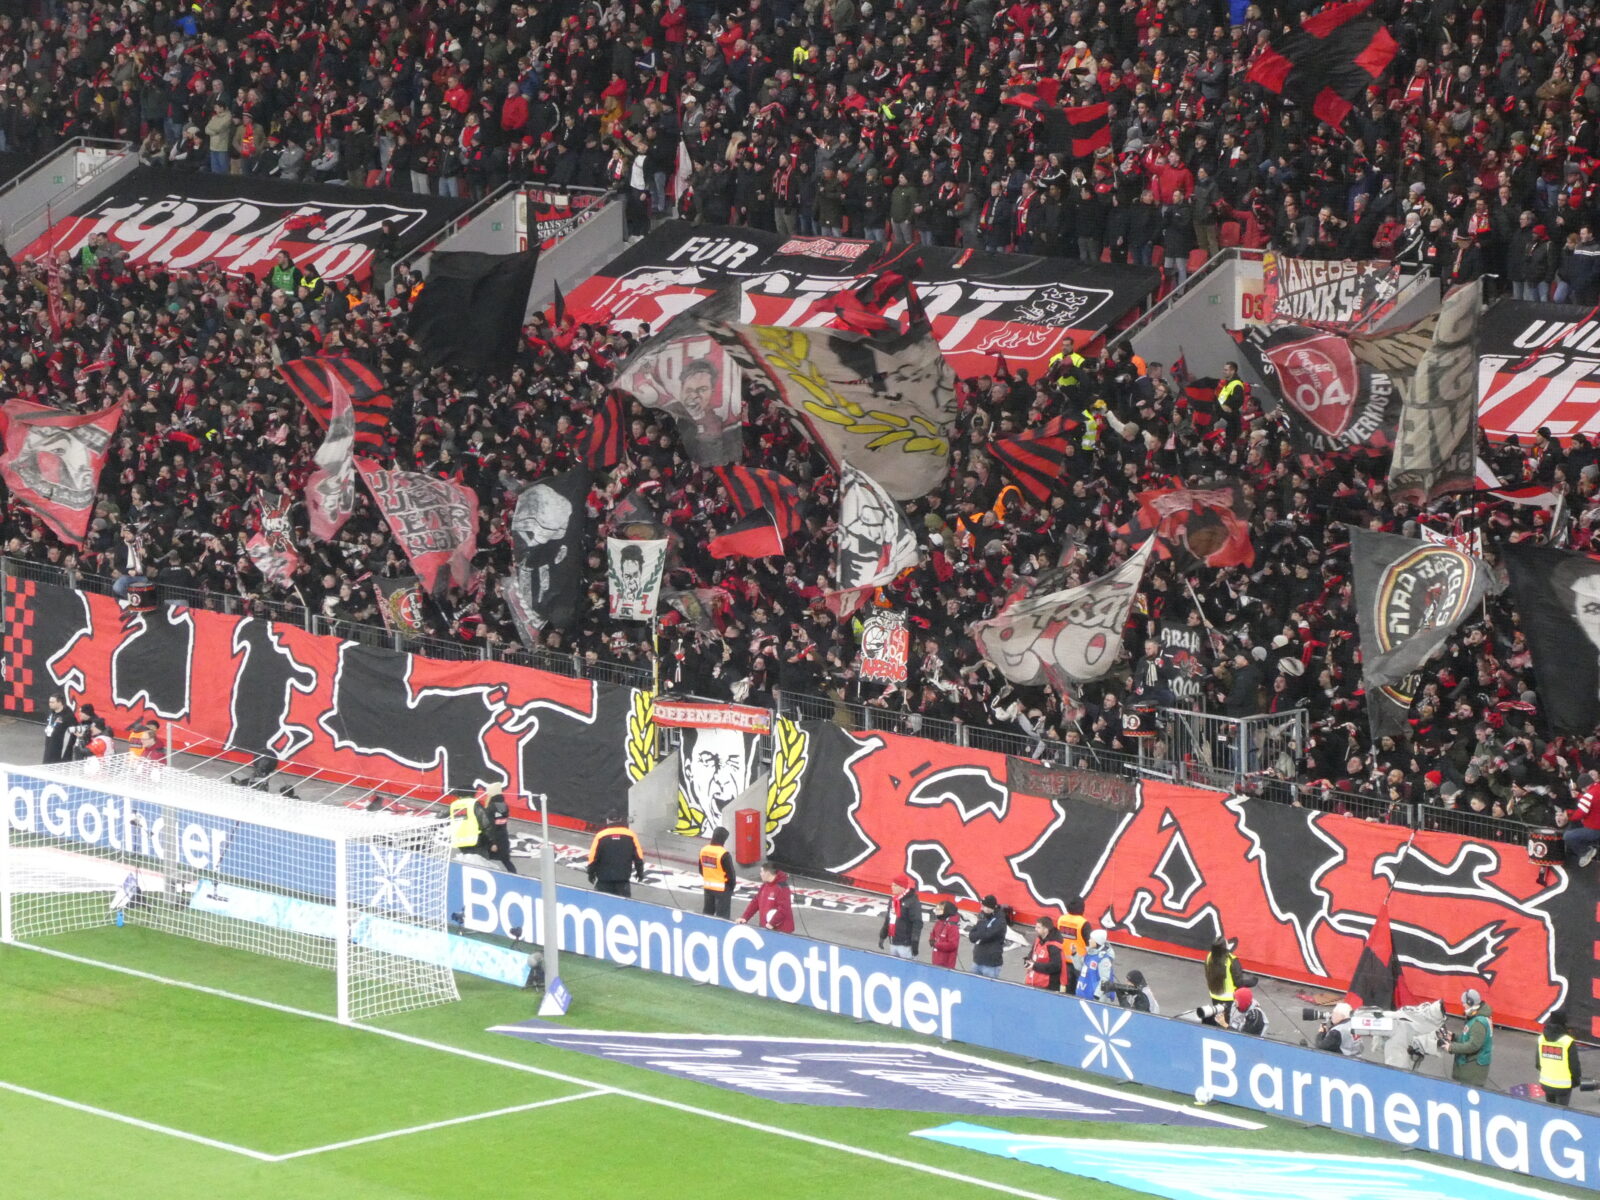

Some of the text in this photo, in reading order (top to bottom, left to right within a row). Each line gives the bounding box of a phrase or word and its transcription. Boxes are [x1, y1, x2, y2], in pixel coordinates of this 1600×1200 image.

[666, 236, 759, 268] FÜR
[1241, 292, 1266, 320] D3
[1296, 383, 1351, 412] 04
[1327, 373, 1392, 451] LEVERKUSEN
[1201, 1037, 1600, 1184] BarmeniaG
